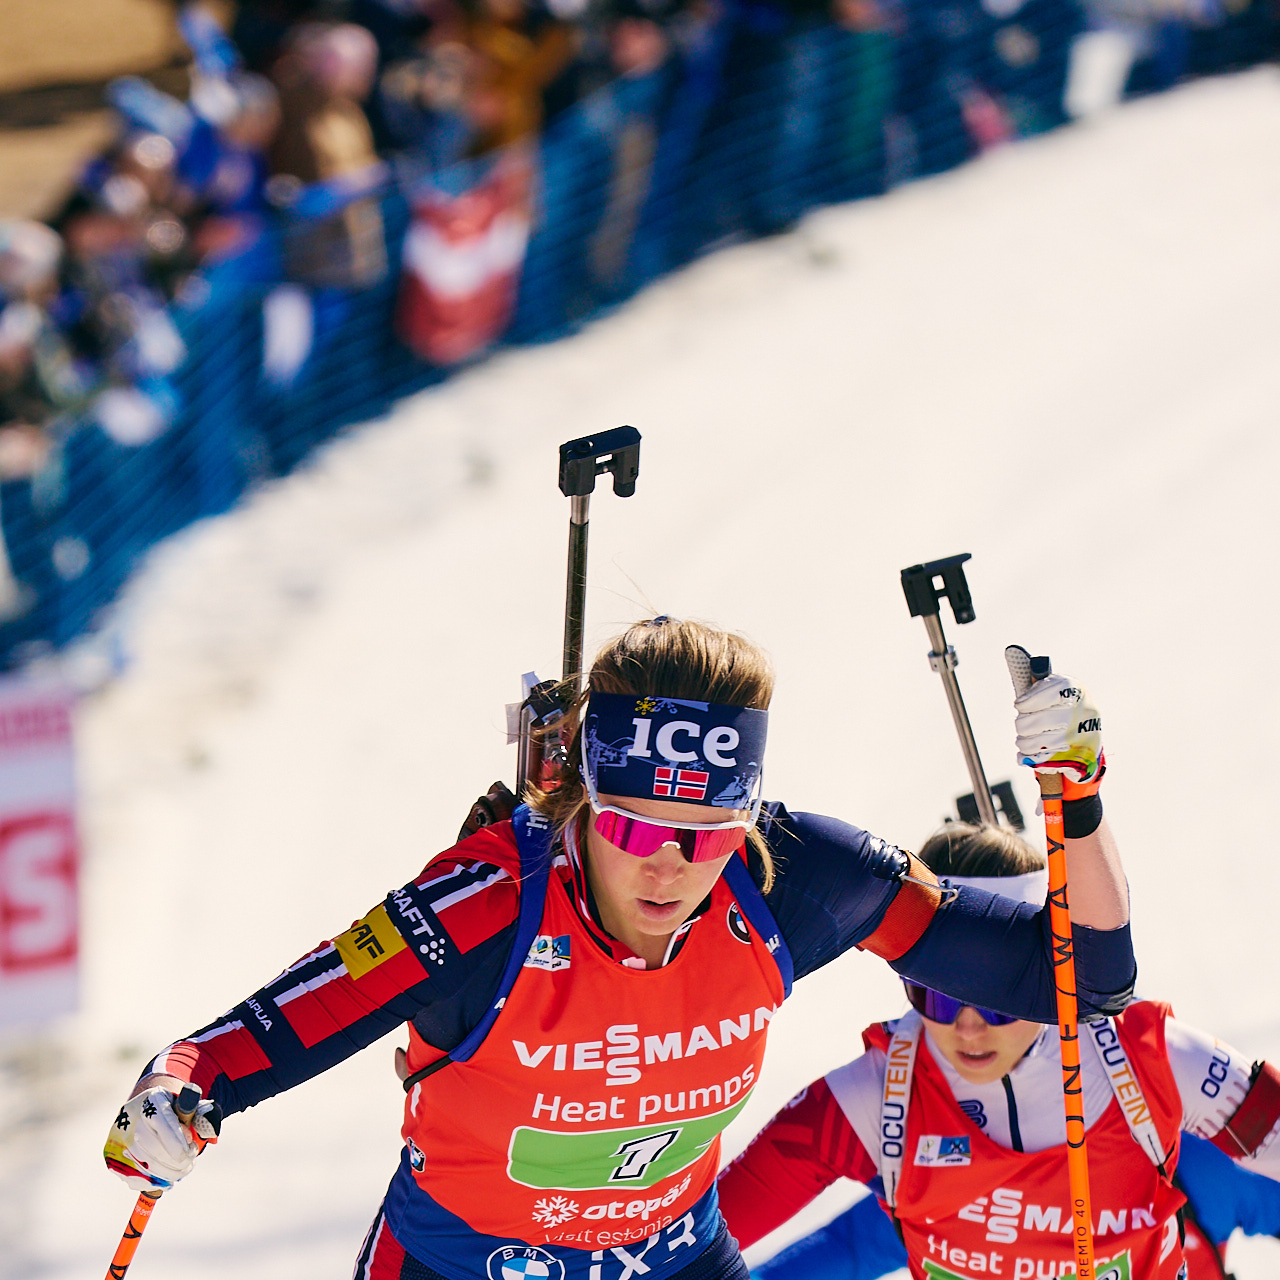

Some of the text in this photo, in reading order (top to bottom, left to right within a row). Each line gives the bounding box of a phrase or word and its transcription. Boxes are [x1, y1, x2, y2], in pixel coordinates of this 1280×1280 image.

[531, 1063, 757, 1123] Heat pumps
[882, 1035, 915, 1158] OCUTEIN
[1076, 1198, 1085, 1218] 40
[597, 1215, 673, 1246] estonia
[927, 1234, 1004, 1275] Heat
